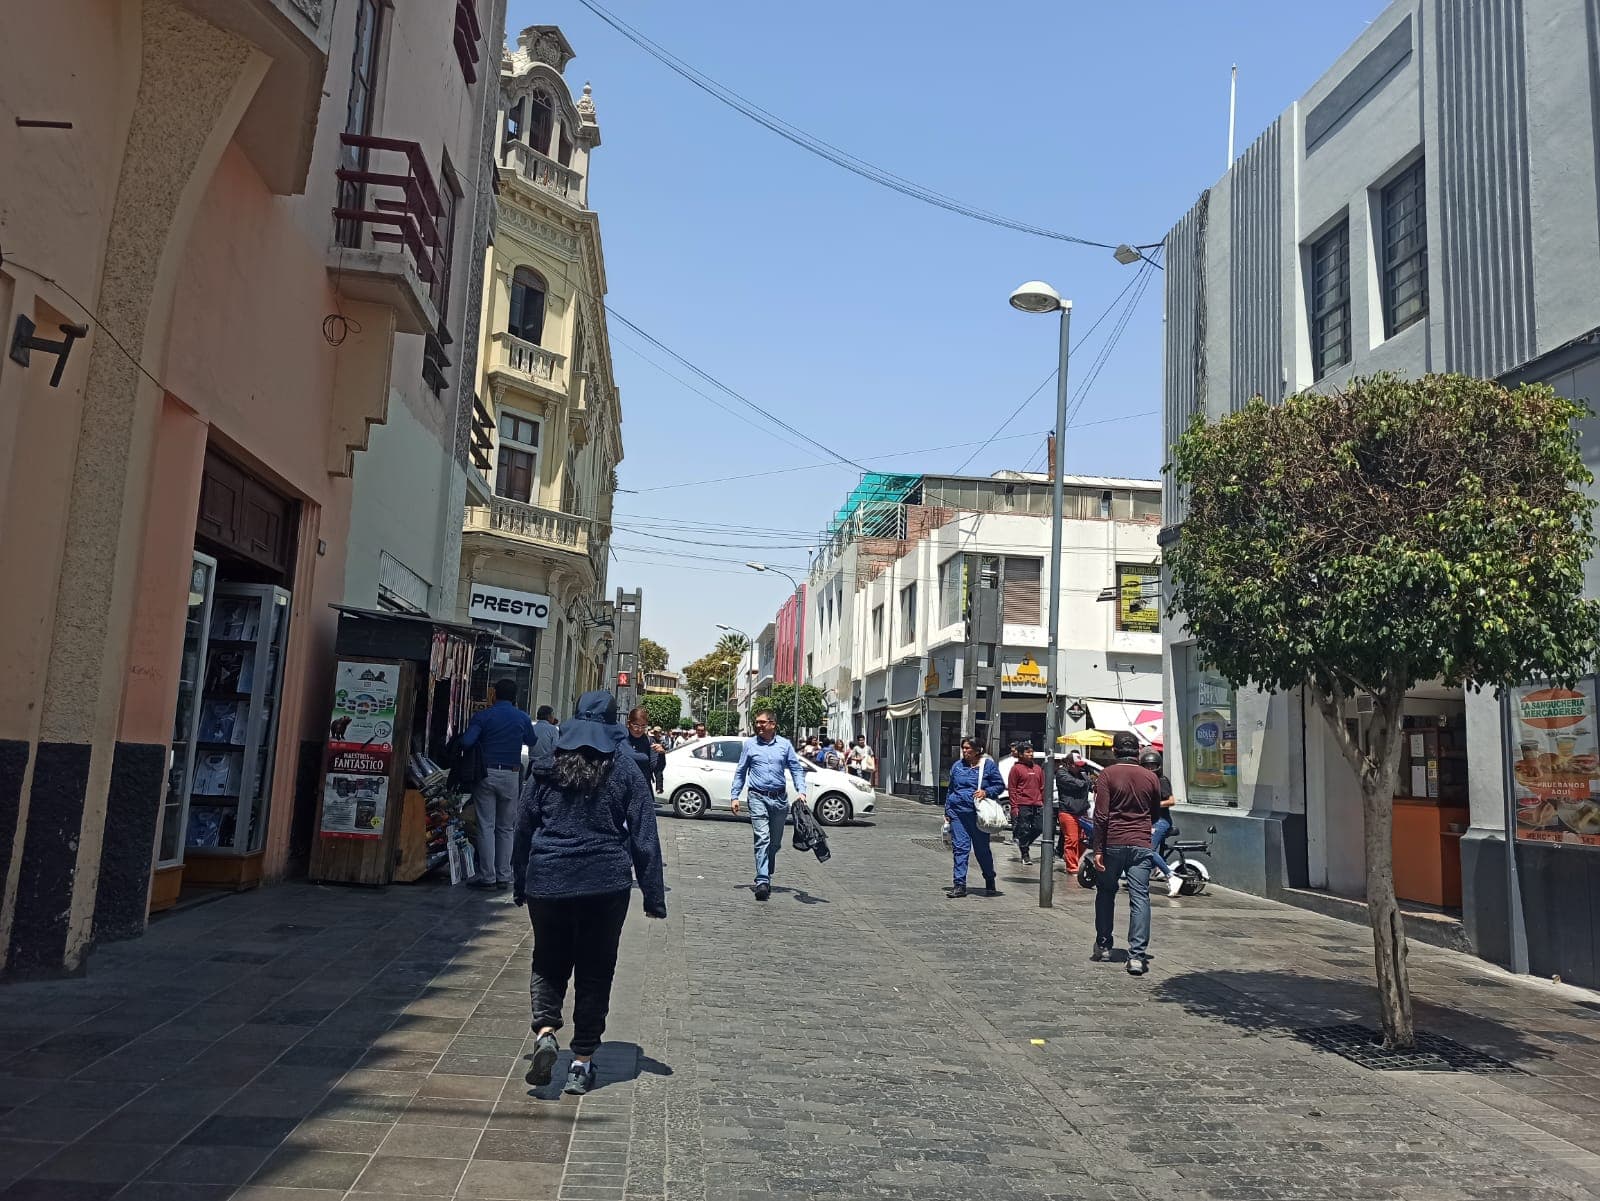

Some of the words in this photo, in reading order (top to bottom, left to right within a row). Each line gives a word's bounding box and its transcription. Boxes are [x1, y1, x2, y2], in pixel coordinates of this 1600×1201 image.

[471, 593, 548, 618] PRESTO
[1521, 702, 1530, 710] LA
[1524, 707, 1582, 717] MERCADERES
